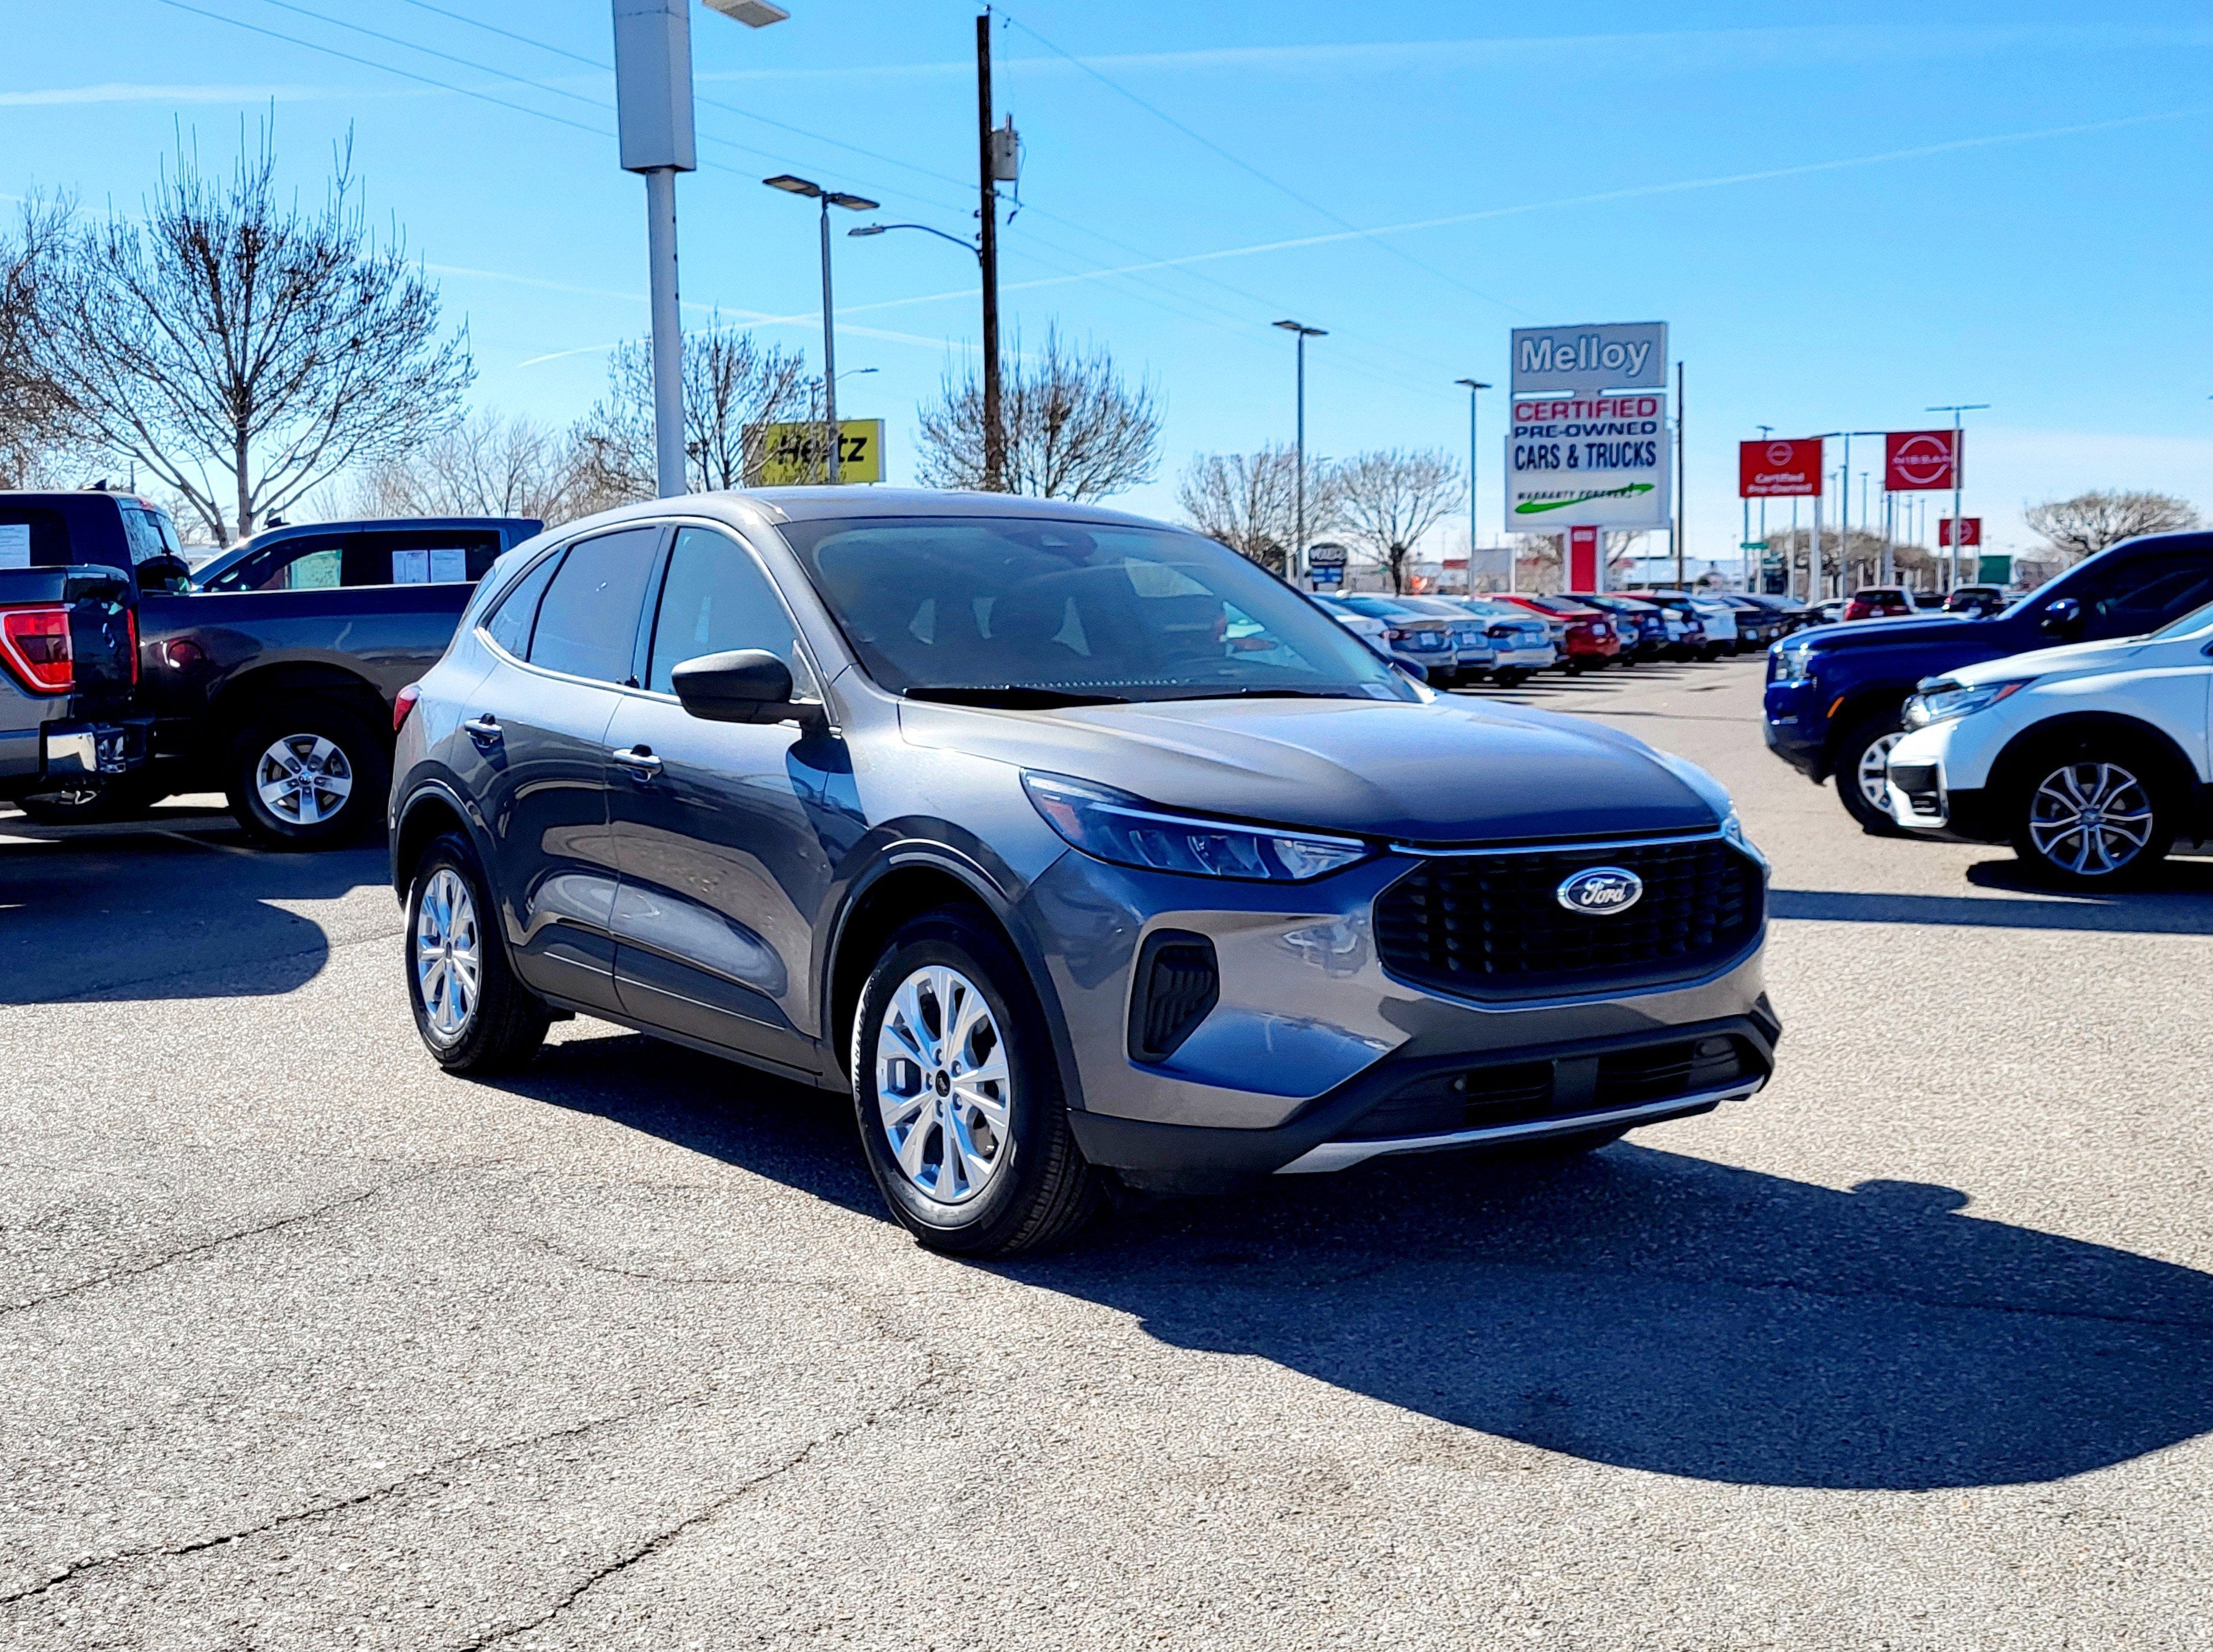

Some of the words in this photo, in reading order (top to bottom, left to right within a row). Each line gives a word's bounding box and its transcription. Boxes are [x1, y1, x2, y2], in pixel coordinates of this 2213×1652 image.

[1520, 335, 1650, 377] Melloy
[1514, 398, 1658, 422] CERTIFIED
[1514, 421, 1657, 439] PRE-OWNED
[1514, 443, 1560, 470] CARS
[1567, 444, 1579, 468] &
[1584, 441, 1657, 469] TRUCKS
[1580, 877, 1627, 905] Ford
